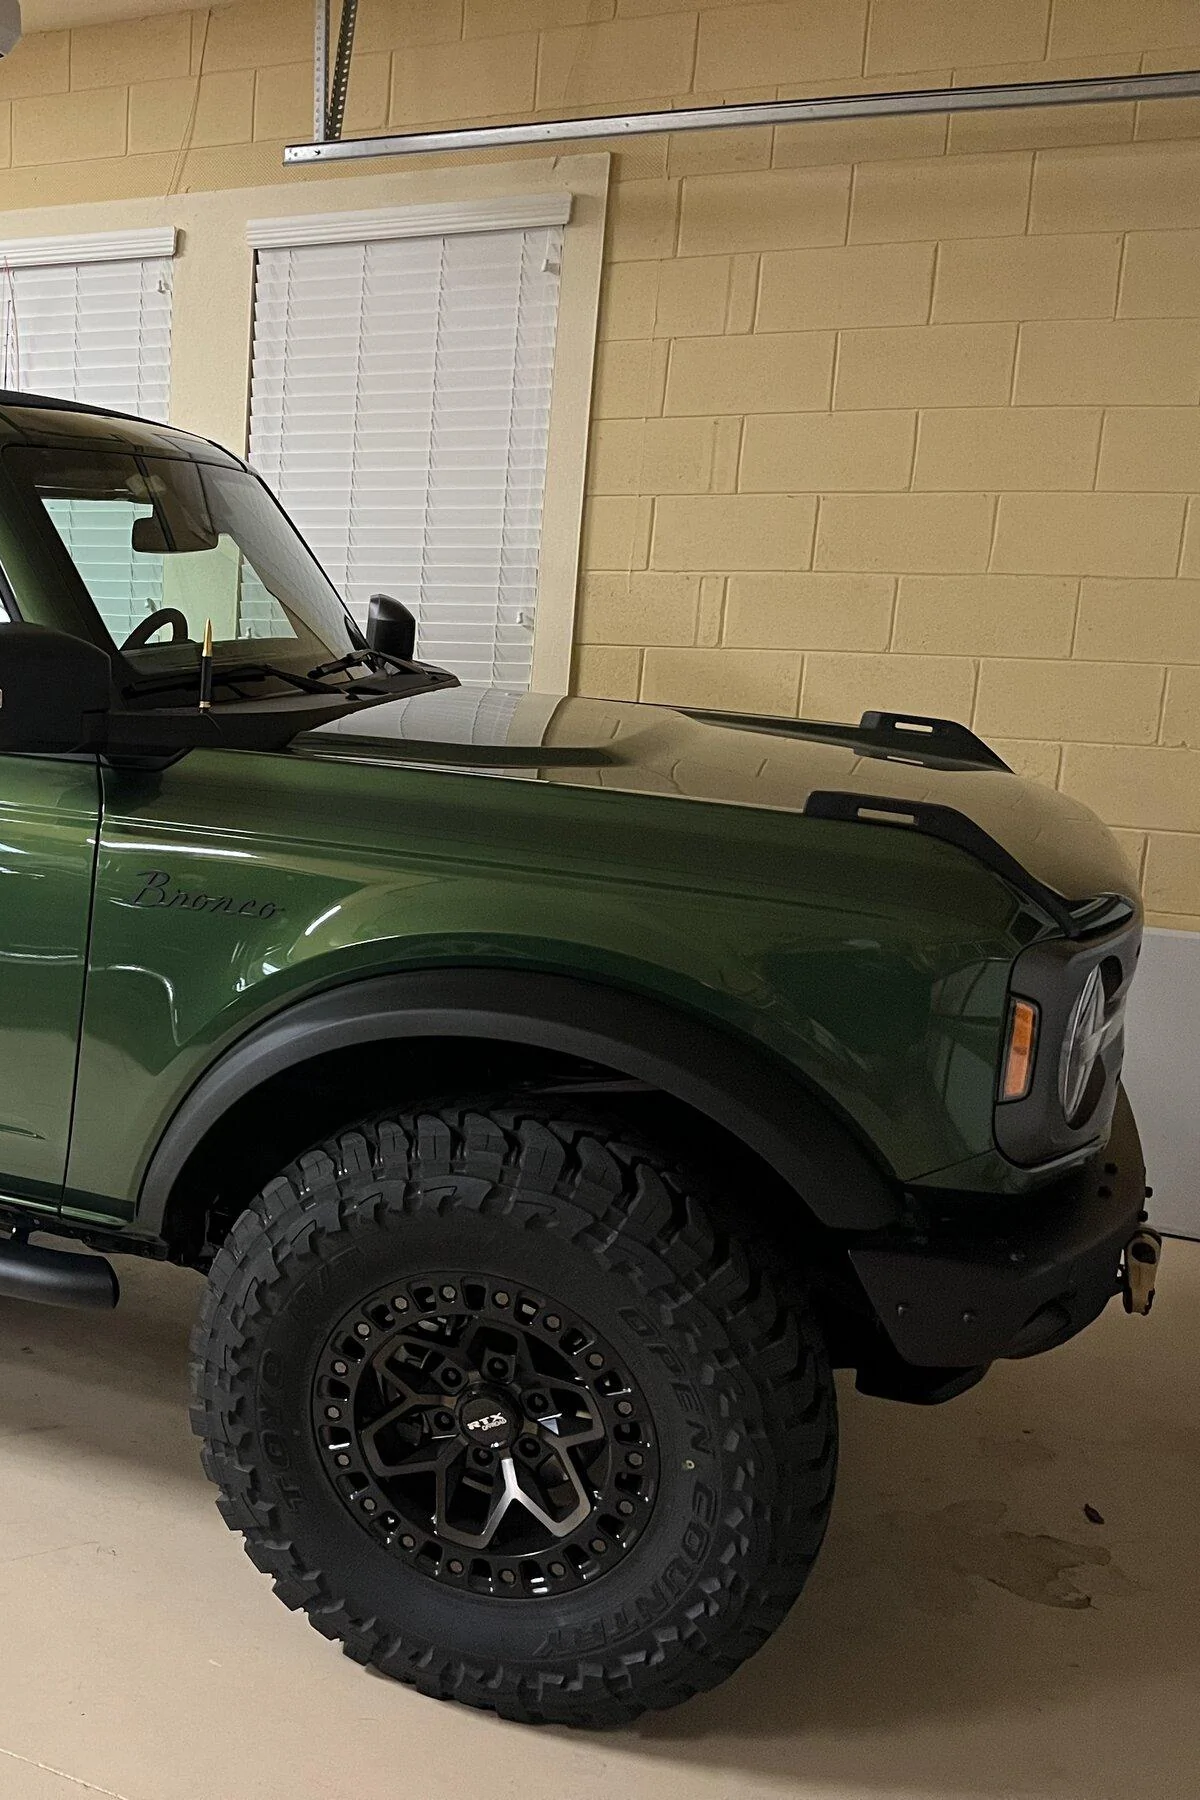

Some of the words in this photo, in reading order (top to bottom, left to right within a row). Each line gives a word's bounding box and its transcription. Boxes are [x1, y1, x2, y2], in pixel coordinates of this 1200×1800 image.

[112, 869, 286, 919] Bronco
[467, 1412, 502, 1430] RTX
[615, 1307, 714, 1456] OPEN
[531, 1480, 721, 1660] COUNTRY
